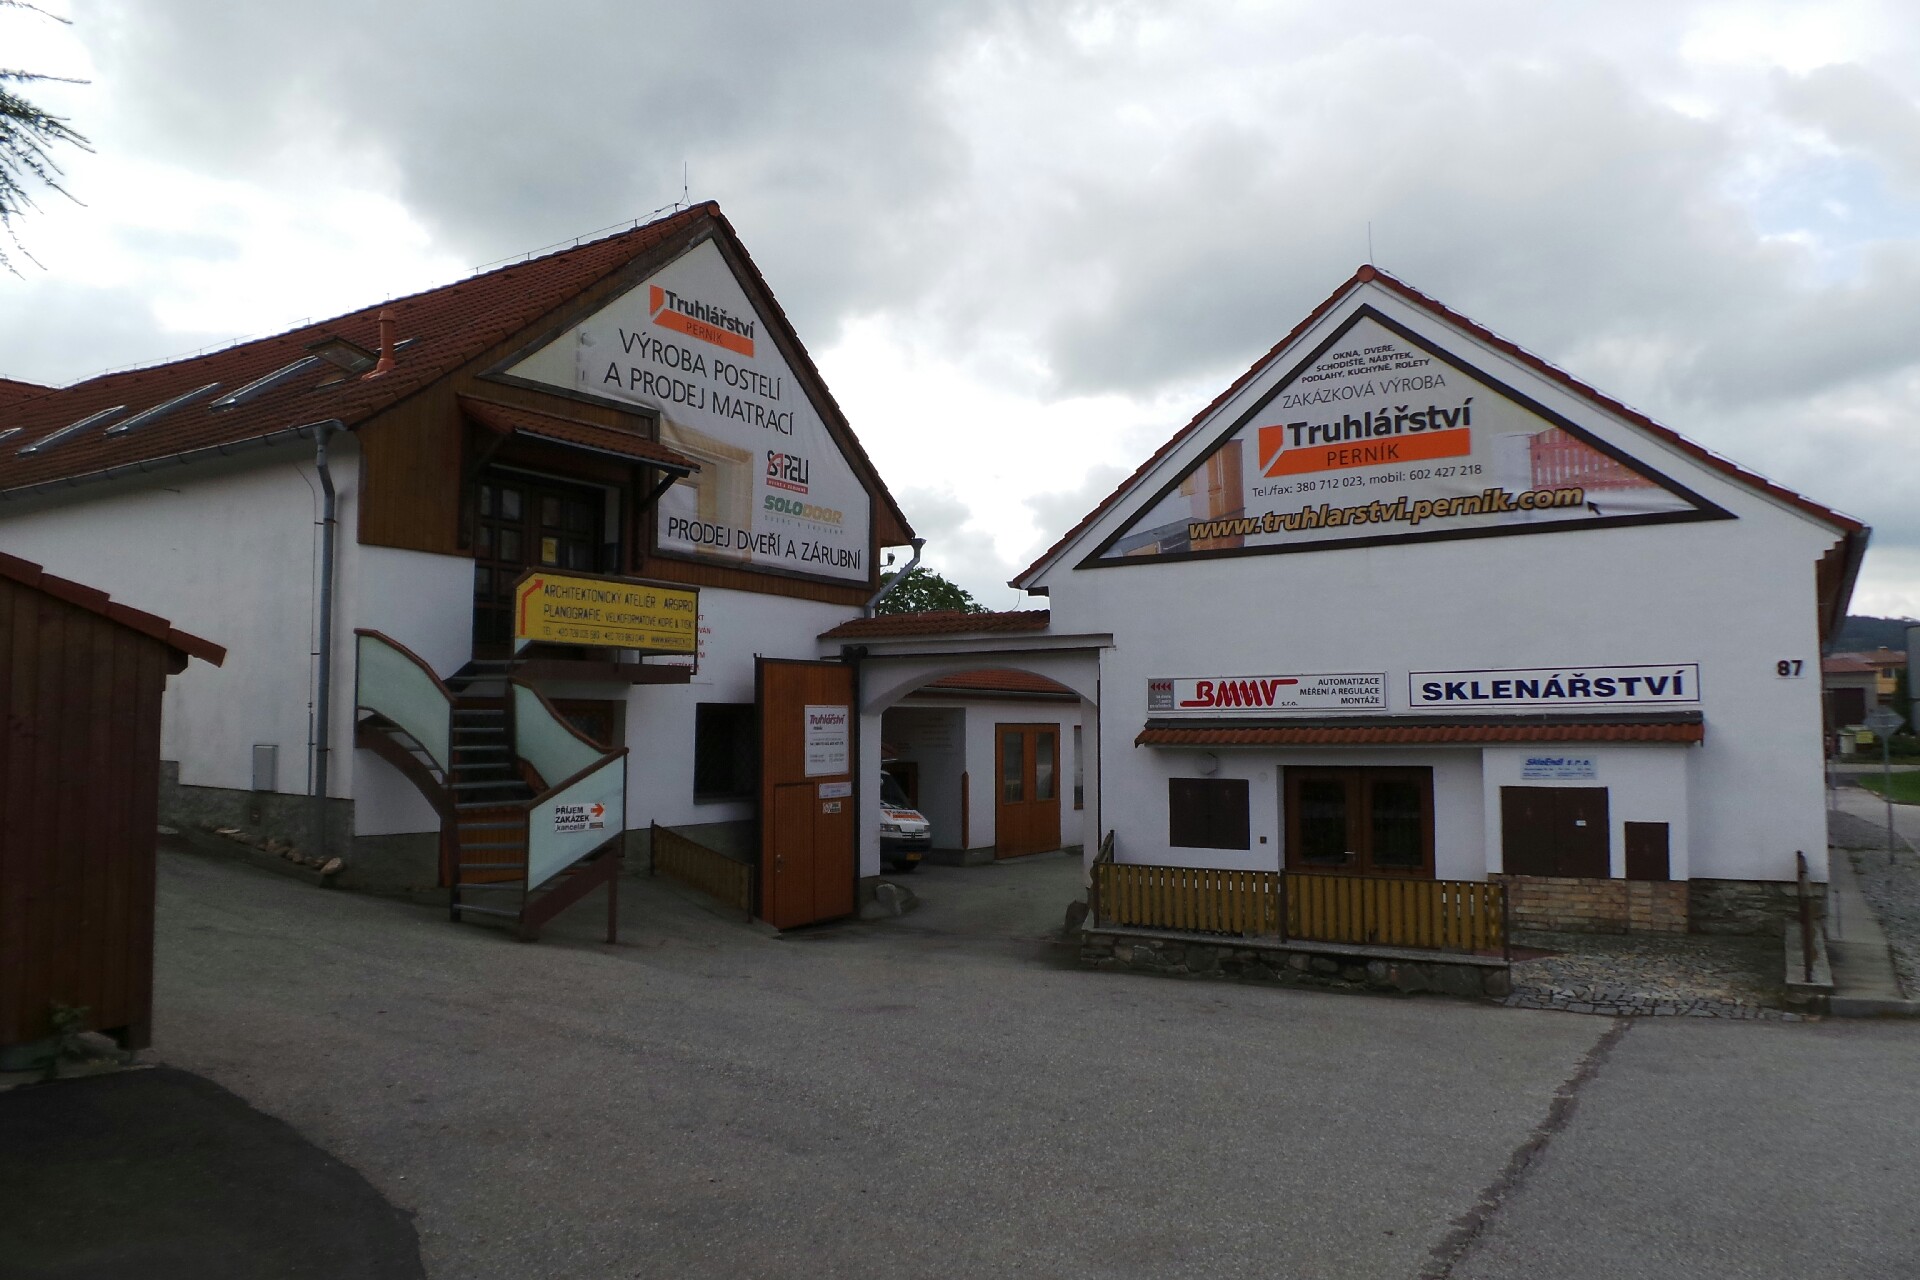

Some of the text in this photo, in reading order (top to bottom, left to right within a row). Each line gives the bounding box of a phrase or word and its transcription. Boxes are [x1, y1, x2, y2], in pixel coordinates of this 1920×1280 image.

[665, 290, 754, 339] Truhlářství
[618, 328, 781, 401] VÝROBA POSTELÍ
[1301, 371, 1345, 384] PODLAHY,
[1395, 358, 1431, 370] ROLETY
[603, 362, 794, 436] A PRODEJ MATRACÍ
[1283, 374, 1446, 409] ZAKÁZKOVÁ VÝROBA
[1287, 397, 1474, 447] Truhlářství
[1326, 442, 1400, 467] PERNÍK
[1296, 482, 1316, 493] 380
[1319, 478, 1339, 489] 712
[1342, 476, 1365, 488] 023,
[1369, 471, 1406, 485] mobil:
[1409, 469, 1430, 480] 602
[1435, 466, 1456, 478] 427
[1460, 464, 1482, 476] 218
[763, 494, 843, 525] SOLODOOR
[1188, 486, 1584, 540] www.truhlarstvi.pernik.com
[668, 516, 861, 570] PRODEJ DVEŘÍ A ZÁRUBNÍ
[624, 591, 656, 608] ATELIÉR
[663, 597, 693, 613] ARSPRO
[1318, 677, 1380, 686] AUTOMATIZACE
[1777, 659, 1803, 676] 87
[1300, 687, 1330, 696] MĚŘENÍ
[1337, 686, 1380, 695] REGULACE
[1340, 695, 1380, 705] MONTÁŽE
[1422, 669, 1685, 702] SKLENÁŘSTVÍ
[555, 805, 583, 815] PŘÍJEM
